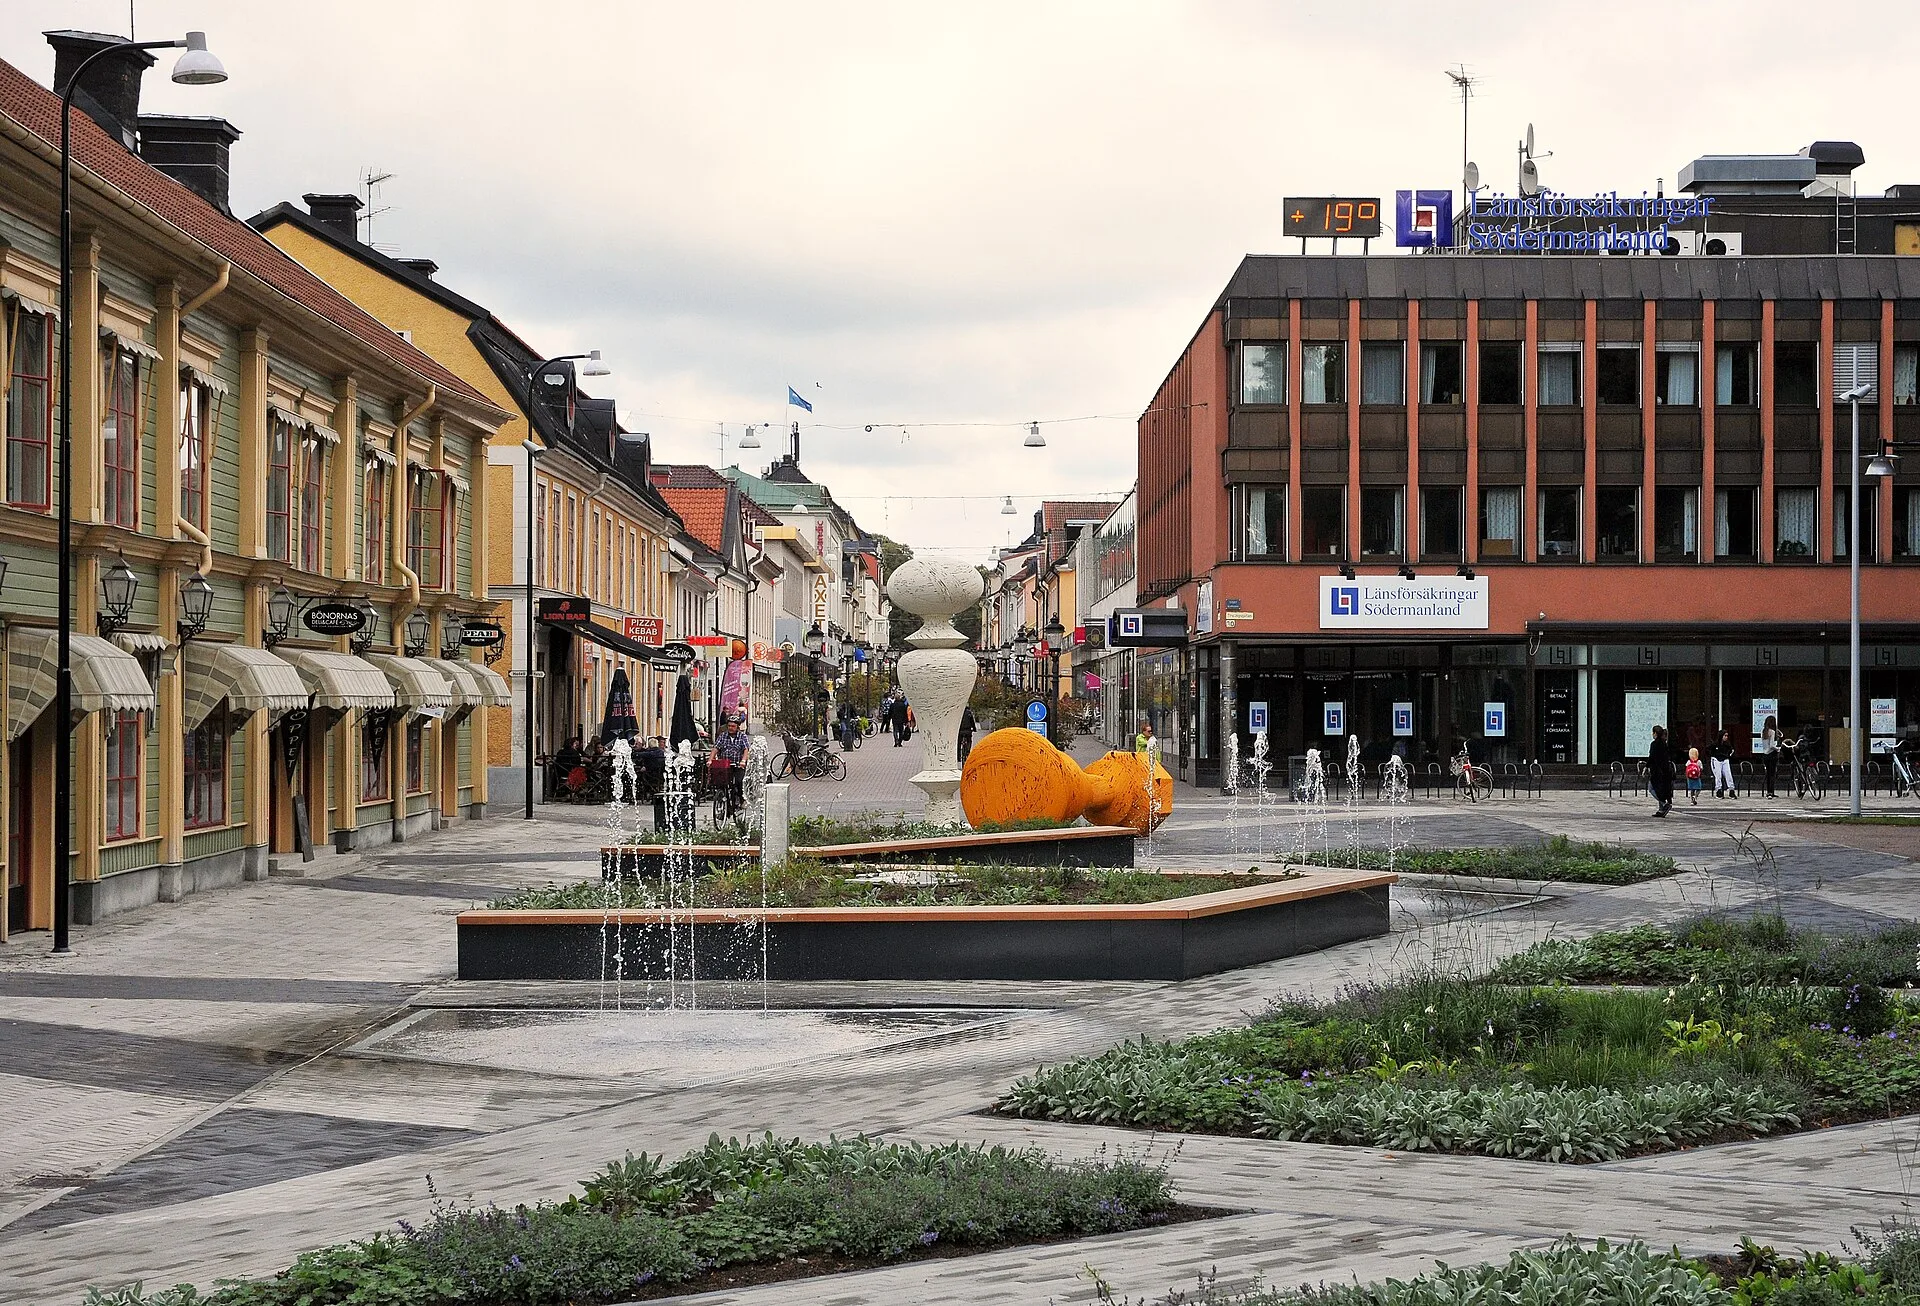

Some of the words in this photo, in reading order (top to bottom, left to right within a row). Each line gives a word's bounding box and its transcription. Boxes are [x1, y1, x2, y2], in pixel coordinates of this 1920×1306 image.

[1470, 189, 1715, 225] Länsförsäkringar
[1468, 222, 1670, 251] Södermanland
[1364, 586, 1479, 604] Länsförsäkringar
[311, 610, 358, 620] BÖNORNAS
[1364, 603, 1461, 616] Södermanland
[631, 619, 657, 627] PIZZA
[628, 628, 658, 636] KEBAB
[631, 635, 655, 644] GRILL
